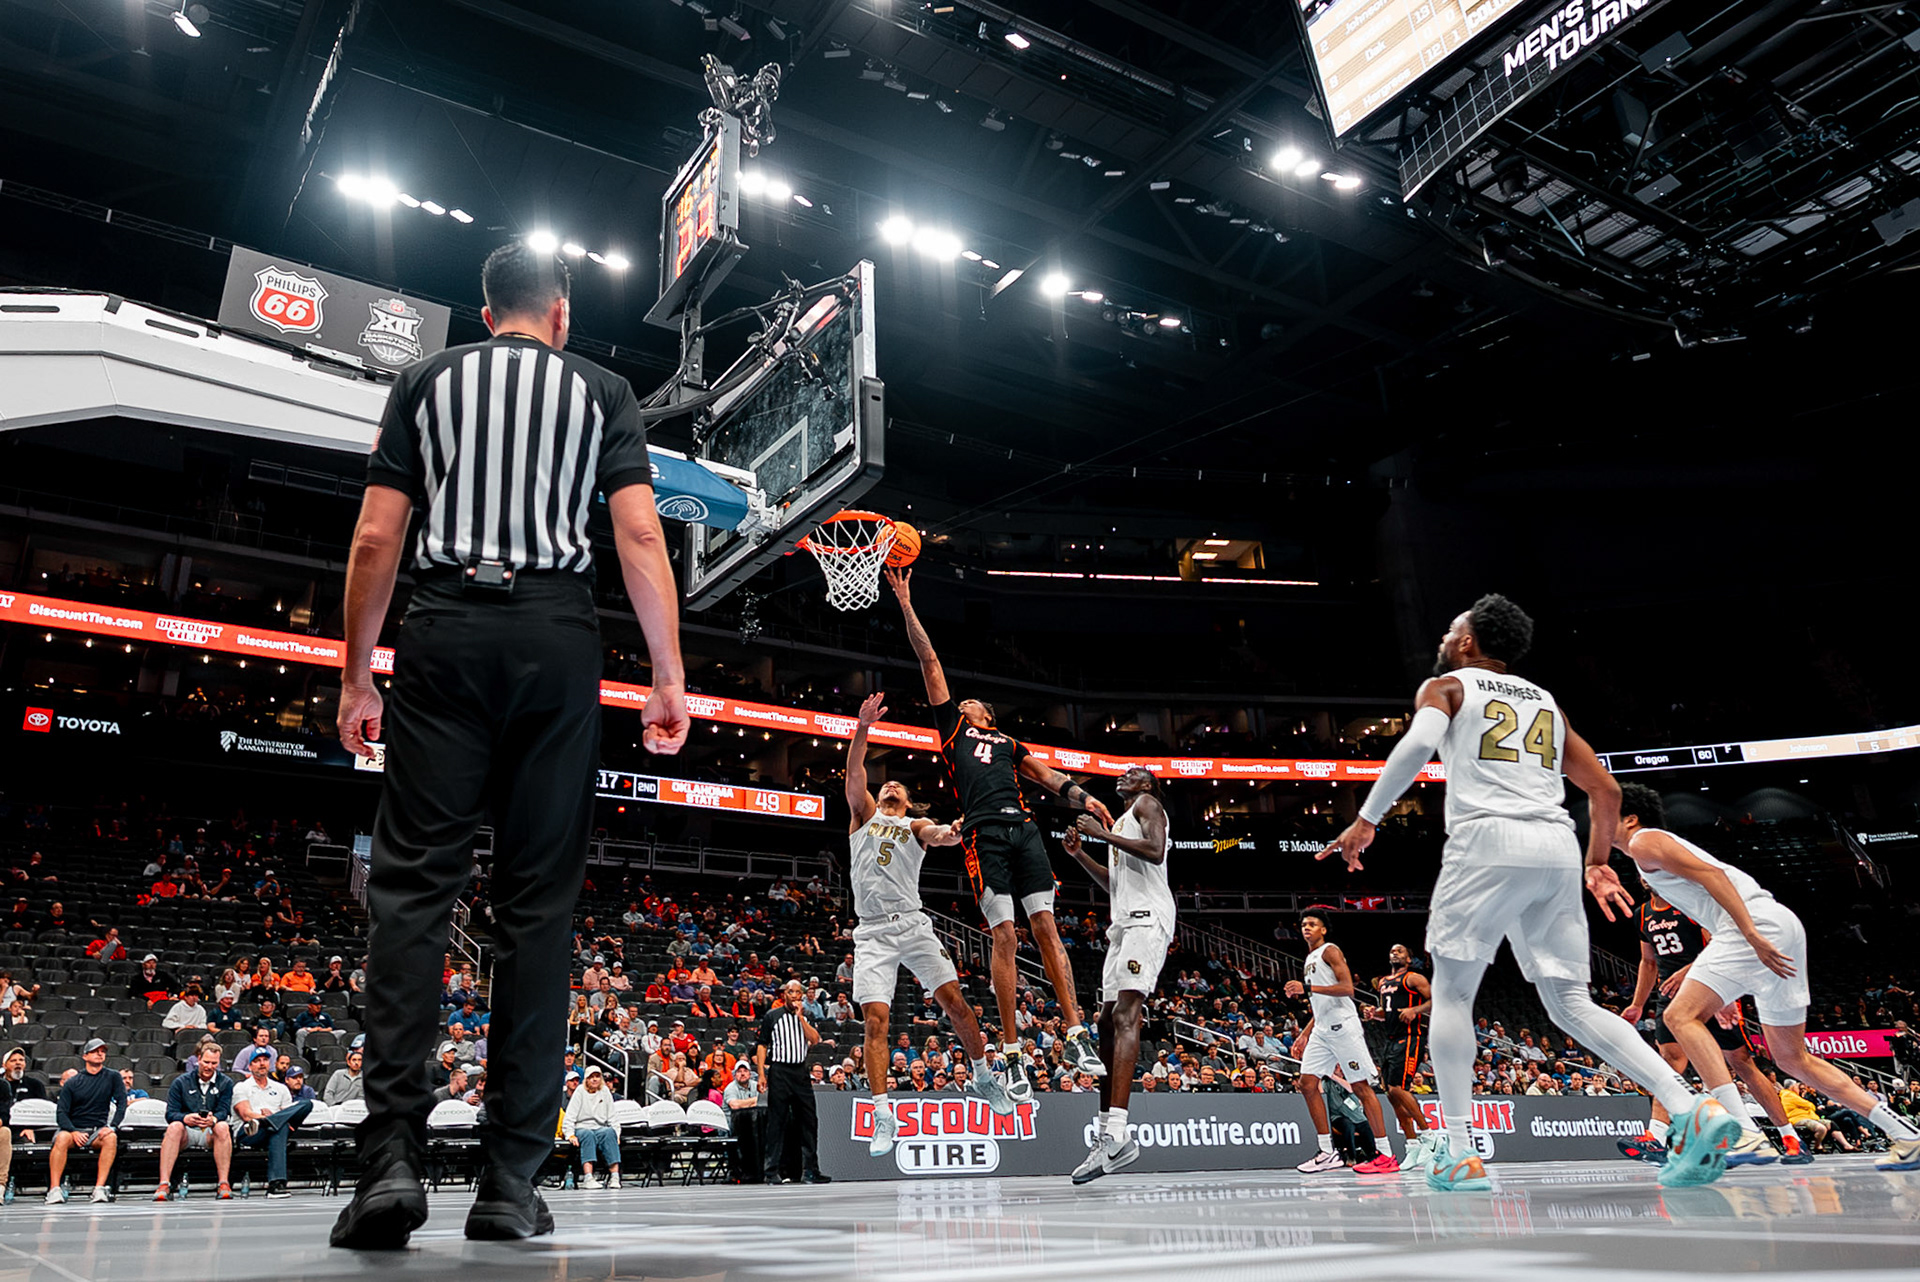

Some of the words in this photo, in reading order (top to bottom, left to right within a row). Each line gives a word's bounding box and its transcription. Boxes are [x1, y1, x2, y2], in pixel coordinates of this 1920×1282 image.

[1425, 43, 1442, 63] 12
[1452, 30, 1461, 43] 1
[1504, 0, 1585, 77] MEN'S
[1543, 0, 1650, 71] TOURN
[1364, 40, 1387, 62] Dak
[266, 275, 317, 299] PHILLIPS
[264, 293, 310, 321] 66
[369, 308, 420, 341] XII
[29, 603, 143, 629] DiscountTire.com
[156, 618, 223, 638] DISCOUNT
[237, 634, 338, 658] DiscountTire.com
[57, 716, 121, 735] TOYOTA
[734, 707, 807, 725] DiscountTire.com
[1478, 699, 1558, 770] 24
[974, 741, 994, 764] 4
[1635, 755, 1669, 766] Oregon
[1222, 763, 1289, 773] DiscountTire.com
[638, 783, 656, 793] 2ND
[671, 782, 735, 798] OKLAHOMA
[685, 793, 720, 806] STATE
[755, 793, 780, 812] 49
[876, 842, 896, 867] 5
[1290, 841, 1325, 852] Mobile
[1653, 932, 1684, 955] 23
[1385, 995, 1393, 1012] 1
[1804, 1035, 1868, 1055] Mobile
[854, 1100, 1034, 1138] DSCOUNT
[1530, 1115, 1647, 1138] discounttire.com
[1083, 1116, 1301, 1147] dcounttire.com
[908, 1144, 987, 1166] TIRE
